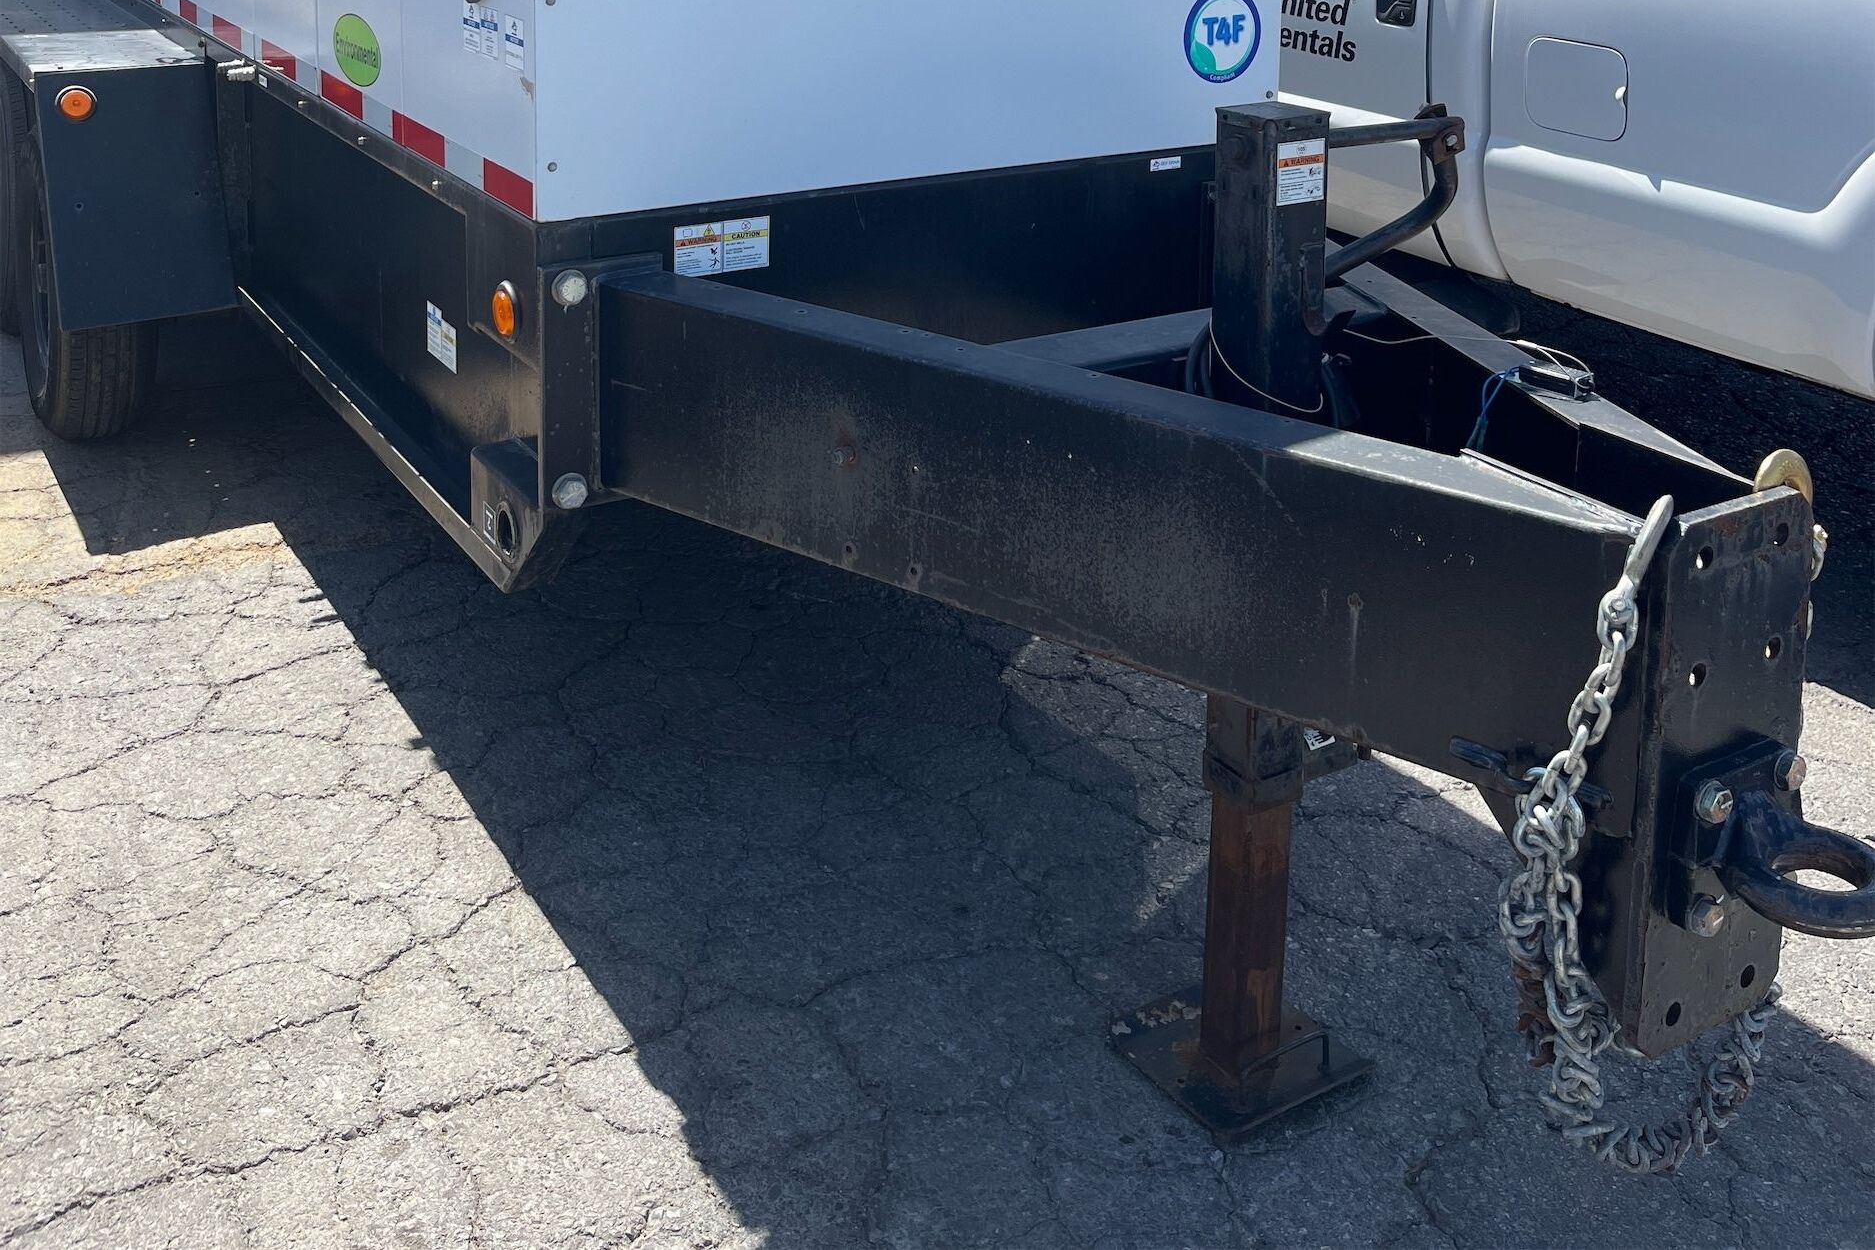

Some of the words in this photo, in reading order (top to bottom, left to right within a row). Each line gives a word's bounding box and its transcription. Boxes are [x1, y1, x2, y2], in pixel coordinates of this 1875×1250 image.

[1202, 14, 1246, 47] T4F
[1280, 27, 1357, 62] entals
[731, 231, 761, 240] CAUTION
